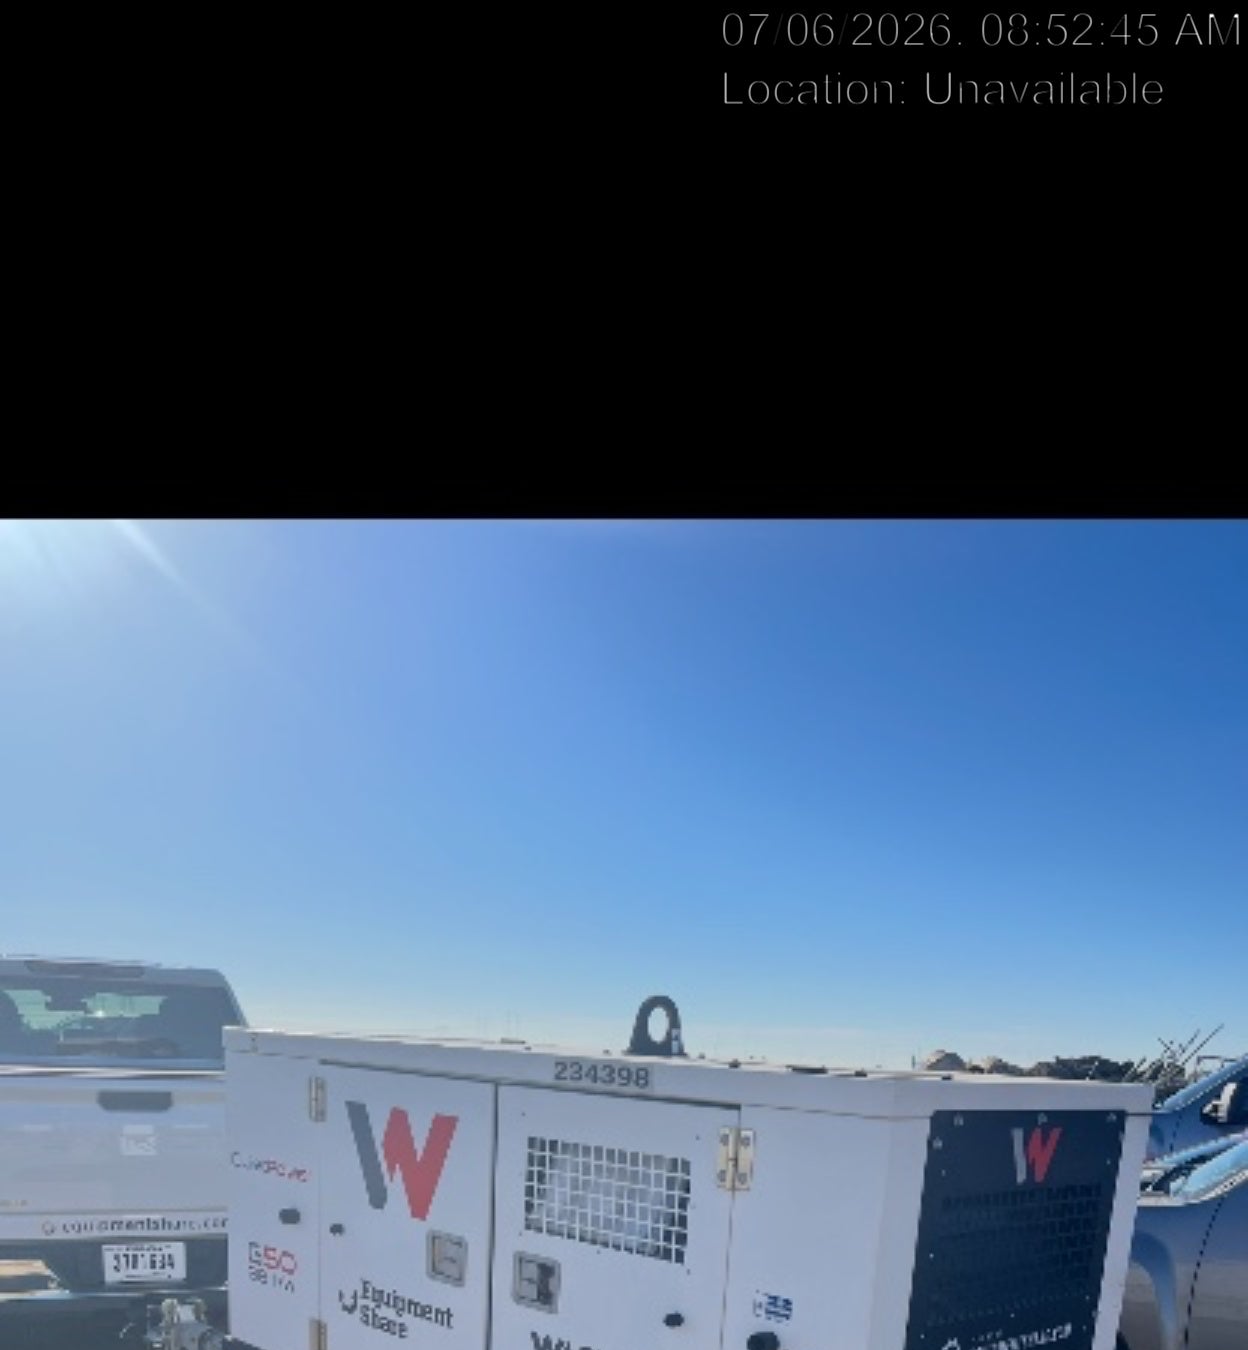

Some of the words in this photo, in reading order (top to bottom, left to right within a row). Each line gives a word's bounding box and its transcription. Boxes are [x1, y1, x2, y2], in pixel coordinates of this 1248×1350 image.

[554, 1061, 649, 1089] 234398
[360, 1304, 408, 1339] Share
[361, 1279, 454, 1329] Equipment
